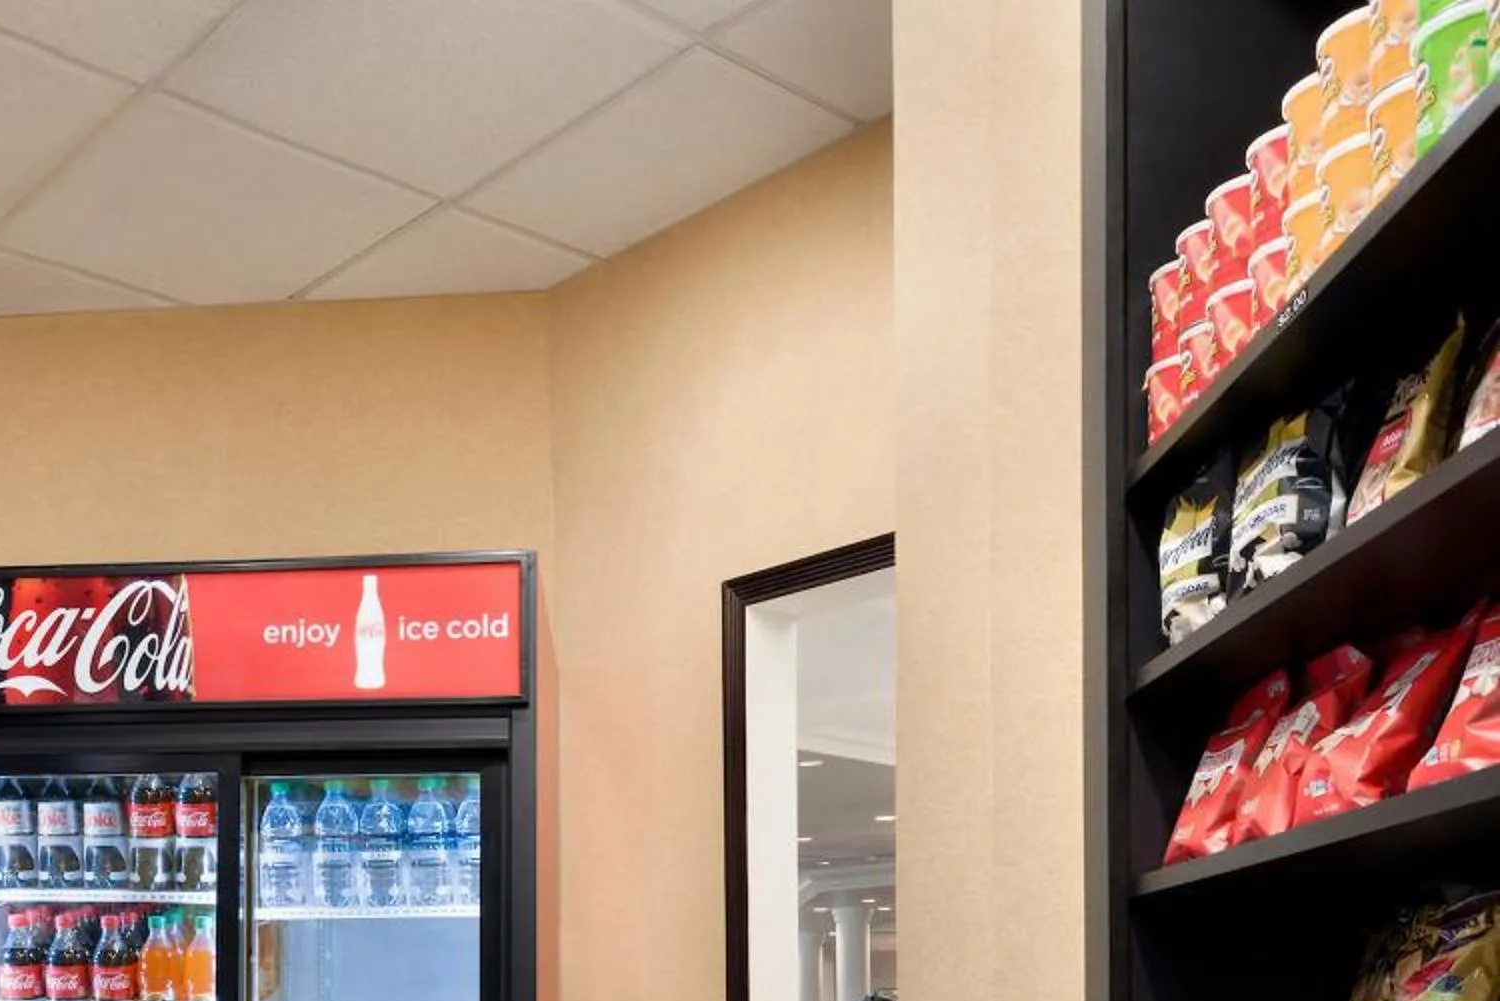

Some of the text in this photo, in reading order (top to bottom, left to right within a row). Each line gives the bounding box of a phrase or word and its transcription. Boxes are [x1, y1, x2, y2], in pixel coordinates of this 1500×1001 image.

[262, 618, 341, 648] enjoy
[398, 615, 439, 641] ice
[446, 612, 510, 640] cold
